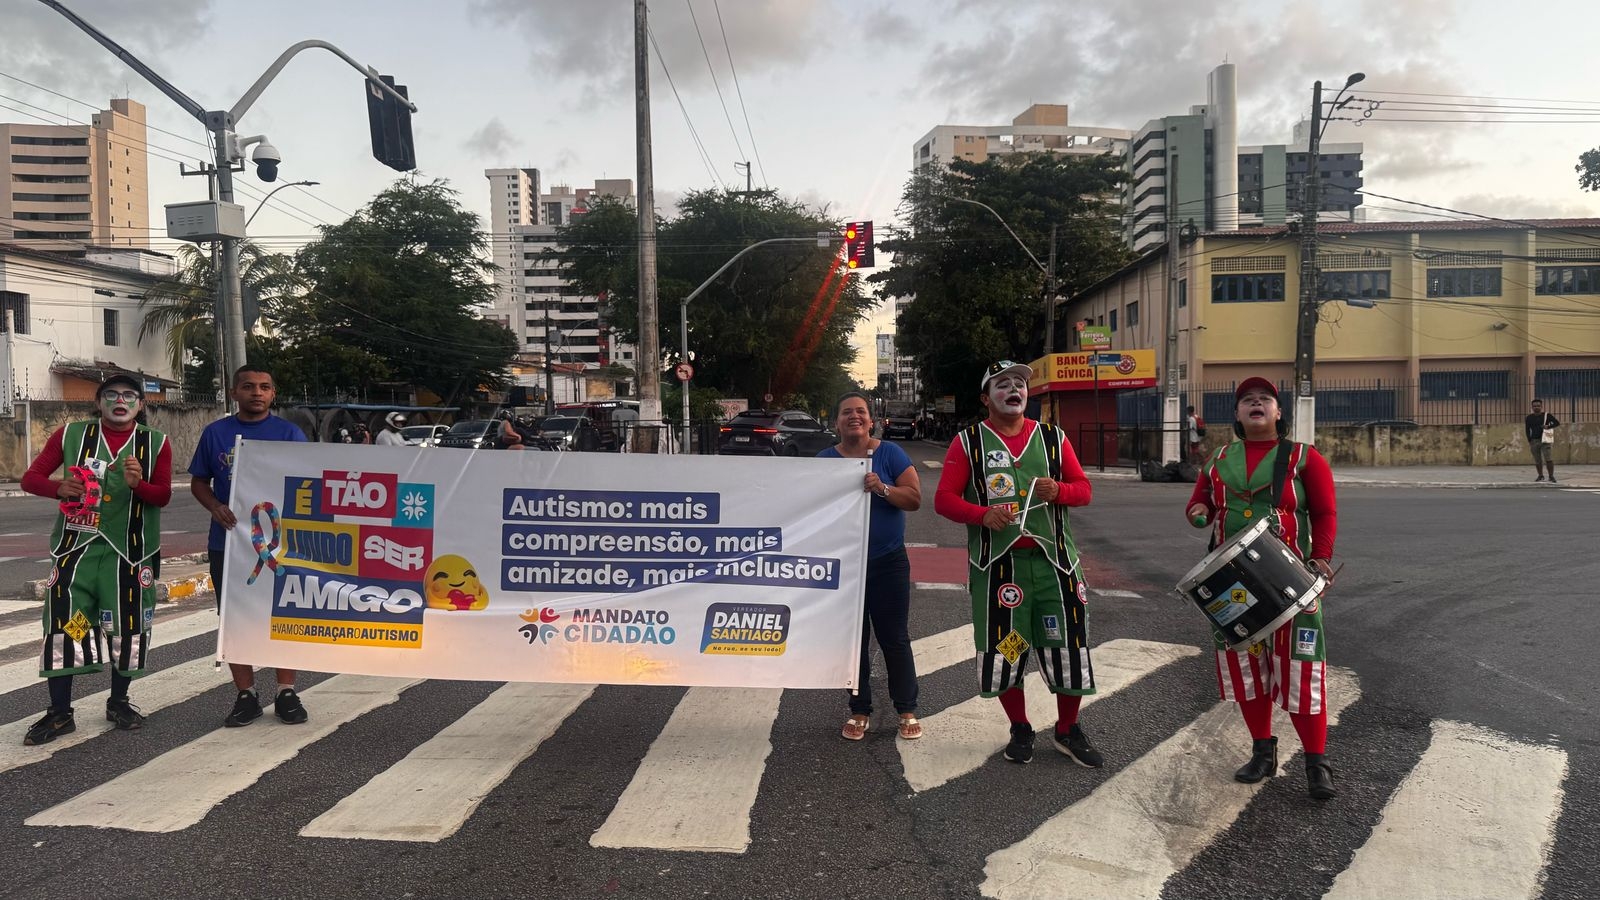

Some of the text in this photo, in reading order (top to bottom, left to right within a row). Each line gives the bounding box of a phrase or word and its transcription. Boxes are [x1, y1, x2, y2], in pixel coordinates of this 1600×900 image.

[1056, 367, 1093, 379] CÍVICA
[295, 471, 387, 515] É TÃO
[508, 494, 708, 520] Autismo: mais
[364, 535, 424, 571] SER
[508, 530, 778, 556] compreensão, mais
[508, 561, 636, 588] amizade,
[715, 556, 833, 581] inclusão!
[278, 574, 423, 614] AMIGO
[572, 608, 669, 625] MANDATO
[712, 612, 783, 630] DANIEL
[564, 621, 676, 645] CIDADÃO
[710, 628, 781, 642] SANTIAGO
